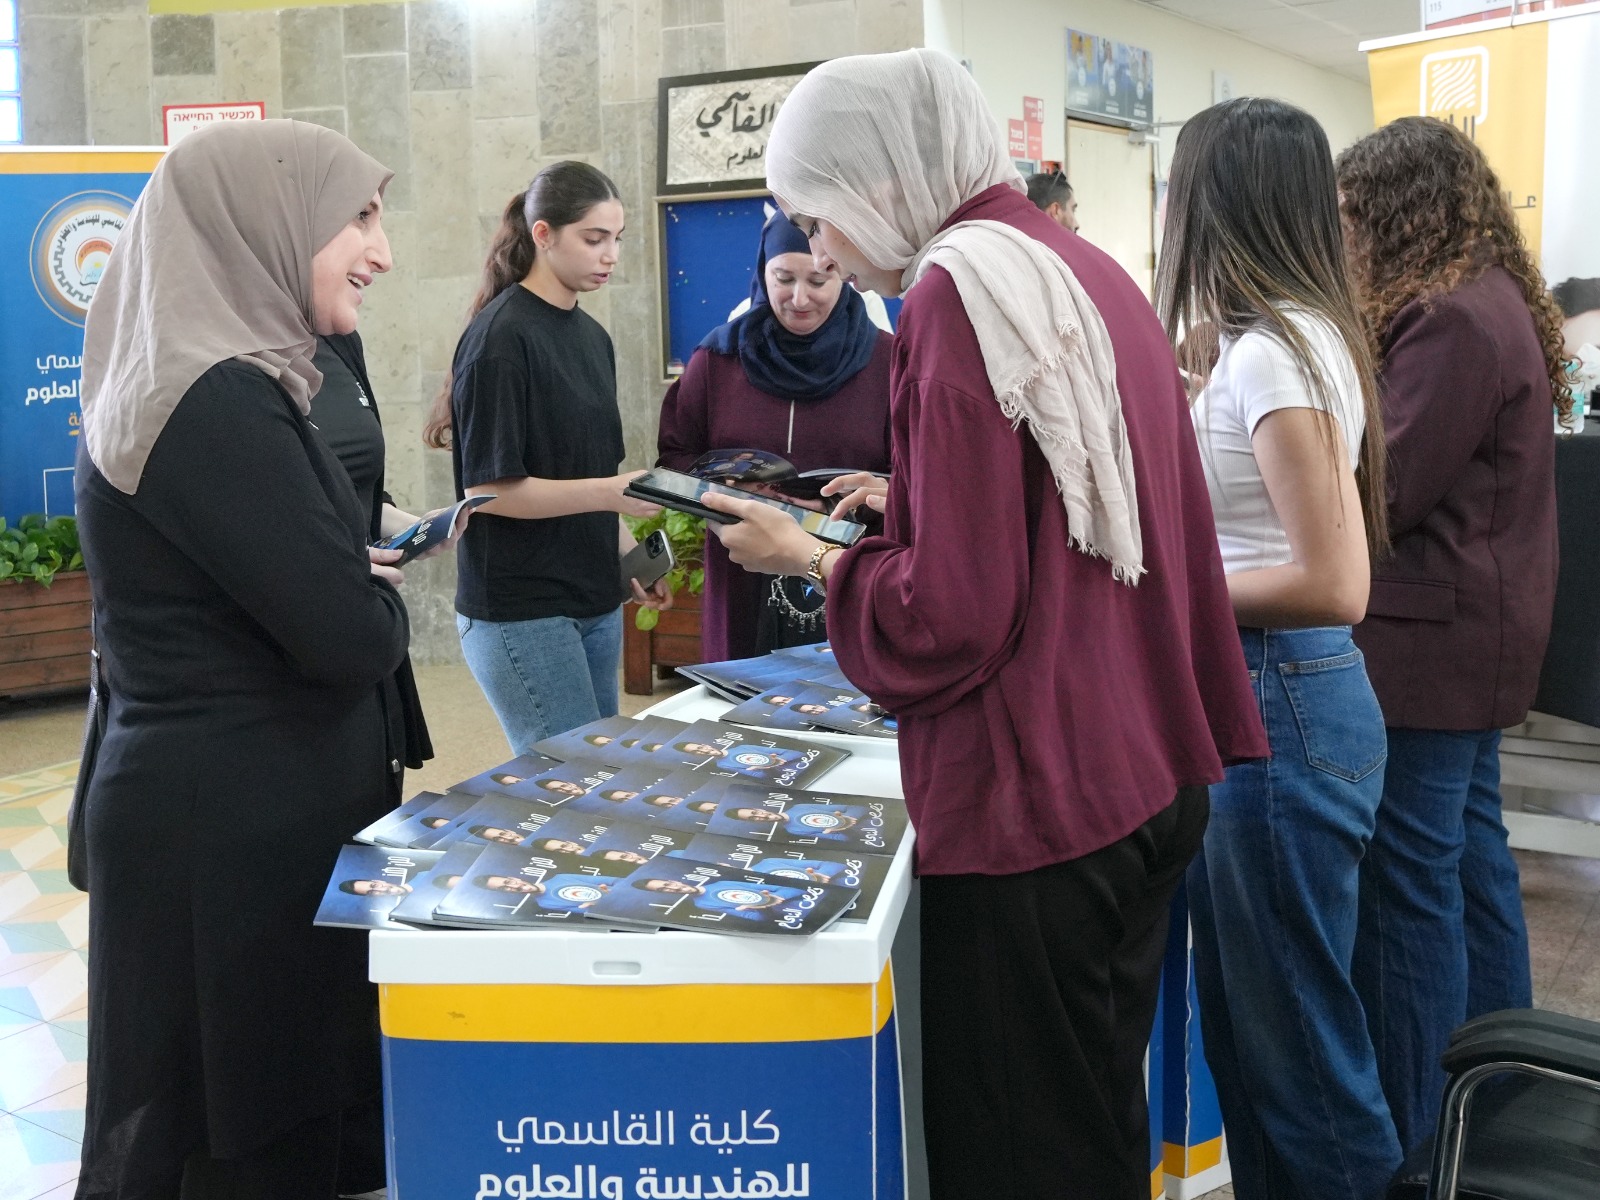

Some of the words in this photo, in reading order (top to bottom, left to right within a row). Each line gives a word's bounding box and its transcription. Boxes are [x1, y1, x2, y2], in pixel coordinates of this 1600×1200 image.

[173, 112, 213, 122] החייאה
[218, 110, 254, 121] מכשיר
[696, 91, 775, 138] القاسمي
[726, 144, 765, 170] لعلوم
[25, 379, 82, 406] العلوم
[497, 1110, 675, 1154] القاسمي
[689, 1110, 780, 1155] كلية
[475, 1164, 624, 1200] والعلوم
[636, 1163, 810, 1199] للهندسة
